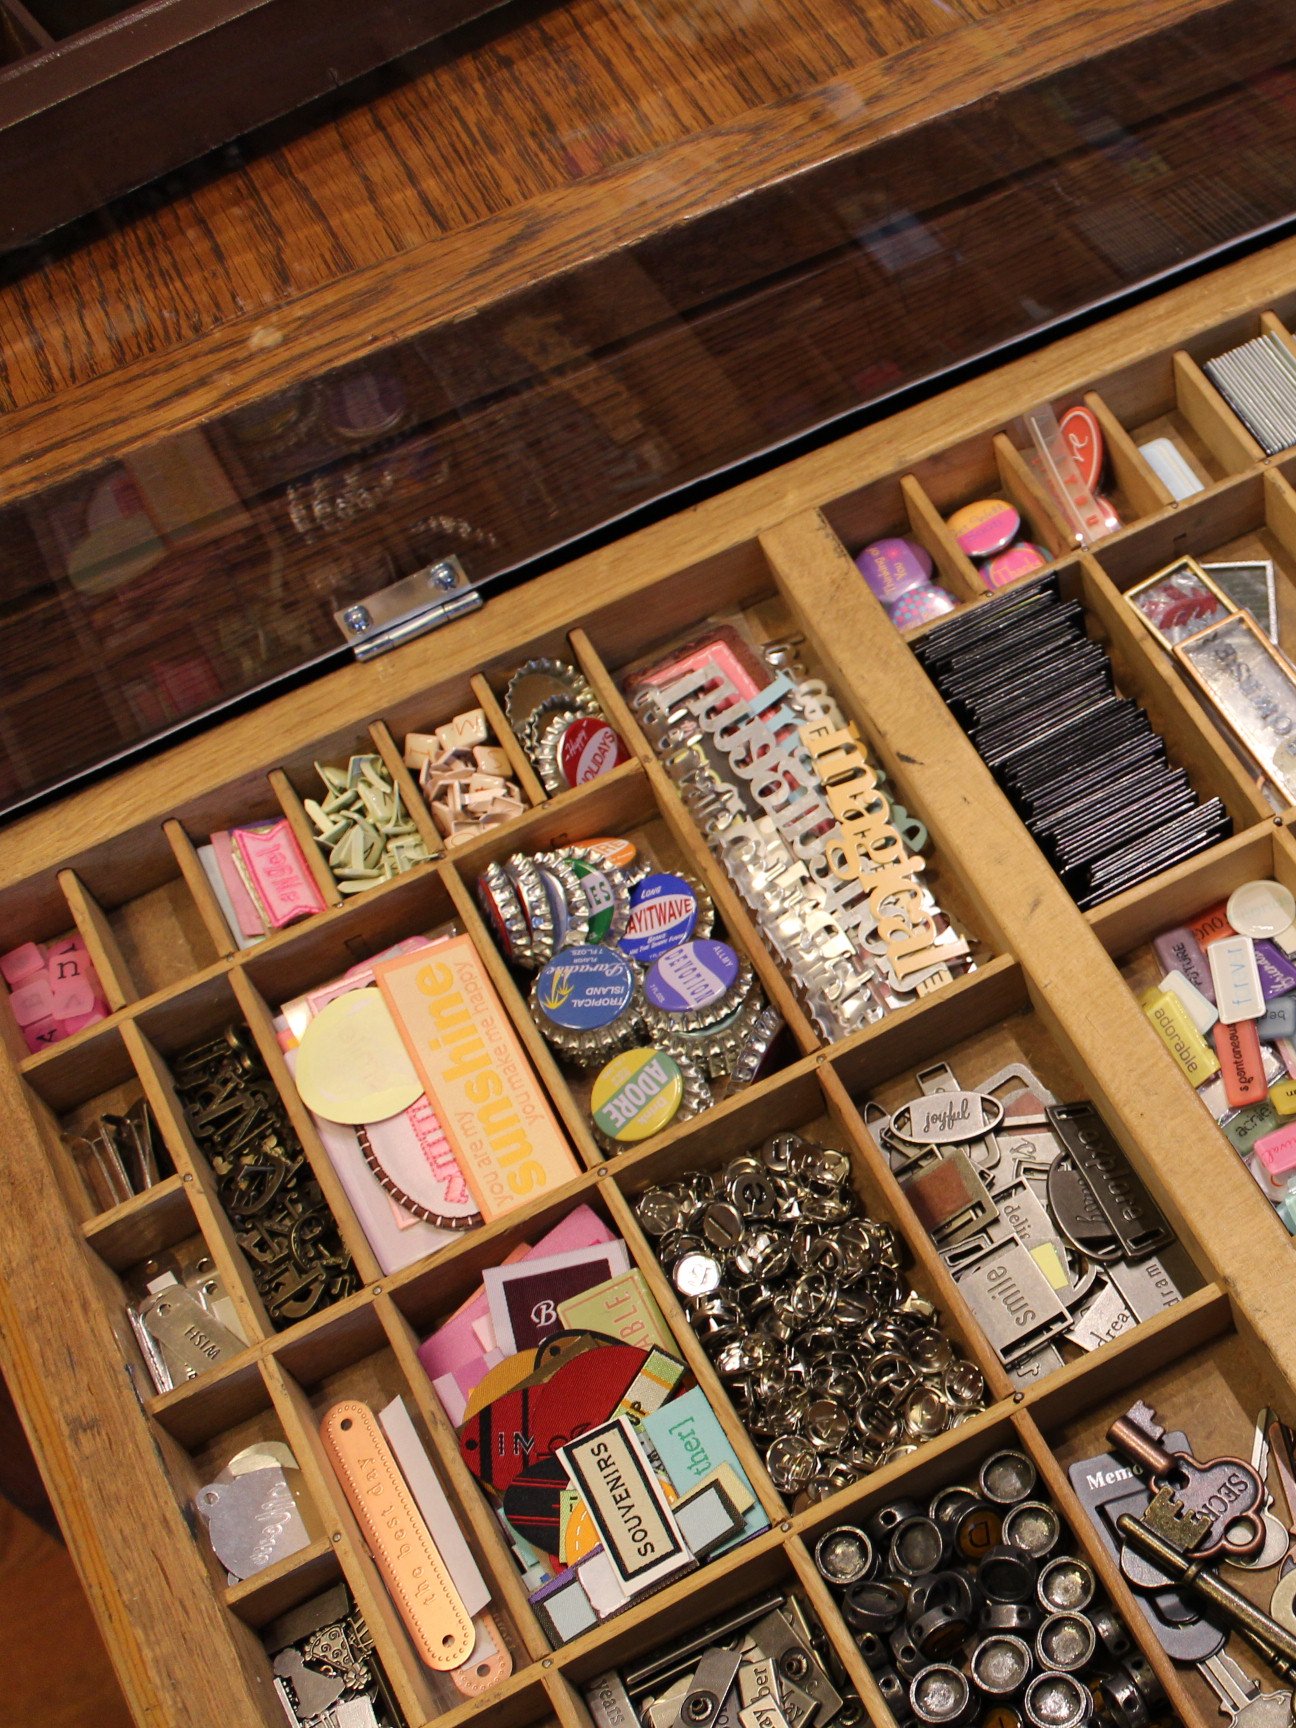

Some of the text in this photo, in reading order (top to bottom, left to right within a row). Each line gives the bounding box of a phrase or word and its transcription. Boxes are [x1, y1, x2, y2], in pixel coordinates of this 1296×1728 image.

[452, 959, 489, 1015] happy
[570, 998, 624, 1008] TROPICAL
[585, 985, 625, 996] ISLAND
[665, 947, 715, 1004] DEVOTION
[1153, 1005, 1199, 1074] adorable
[415, 960, 548, 1196] sunshine
[490, 1046, 524, 1090] make
[601, 1058, 669, 1128] ADORE
[923, 1098, 971, 1133] joyful
[466, 1140, 493, 1169] are
[1076, 1127, 1144, 1223] explore
[984, 1264, 1036, 1329] smile
[182, 1324, 222, 1361] WISH
[590, 1440, 656, 1559] SOUVENIRS
